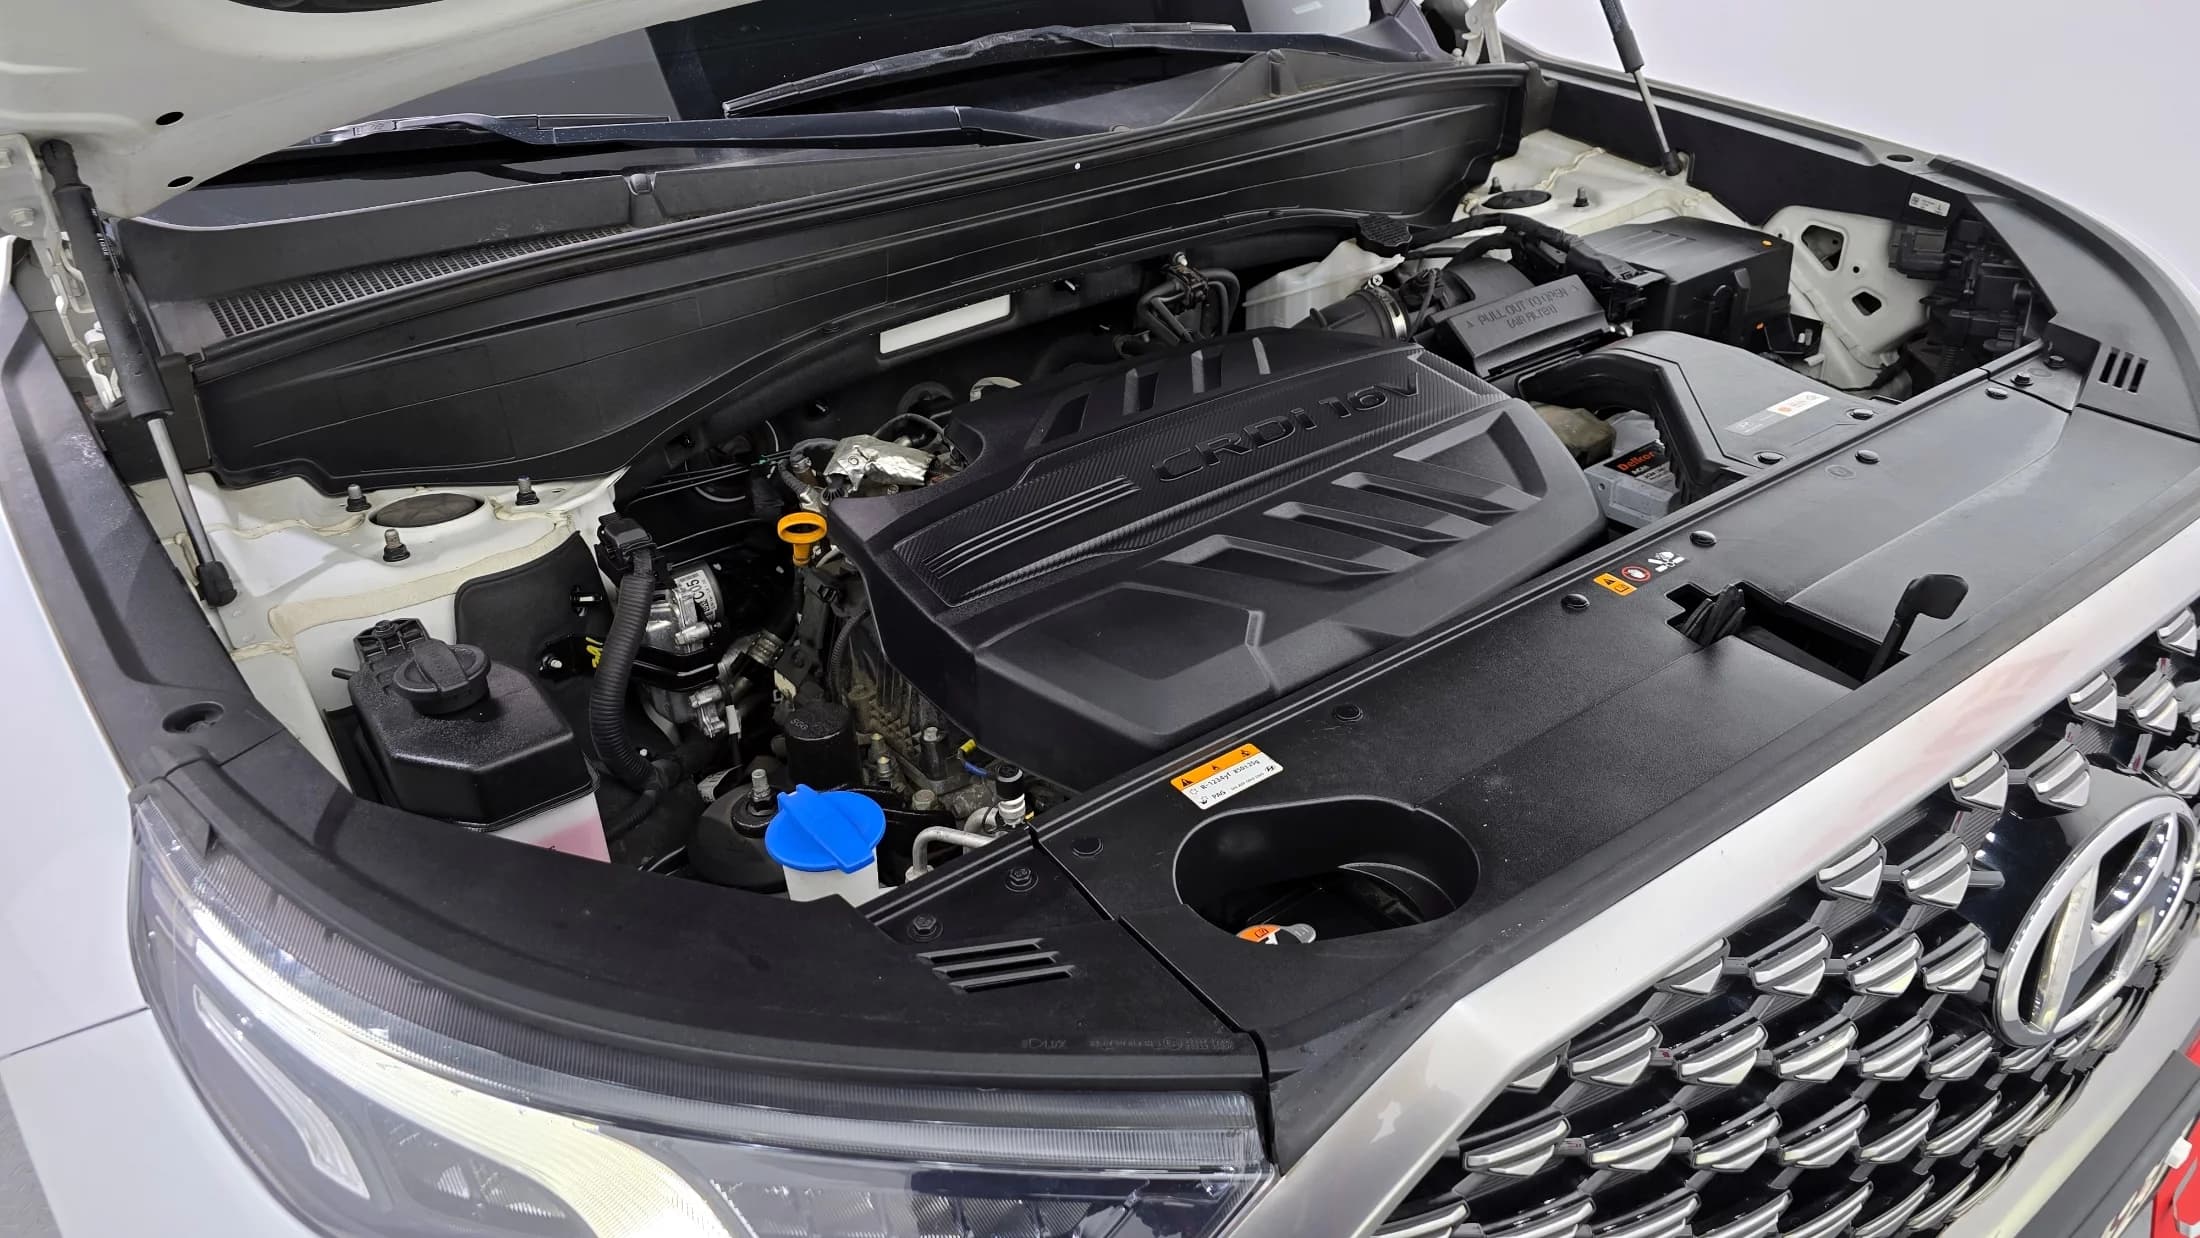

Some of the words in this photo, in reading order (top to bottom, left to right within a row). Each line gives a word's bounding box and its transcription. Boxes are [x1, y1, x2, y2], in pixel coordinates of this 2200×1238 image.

[1478, 308, 1507, 325] PULL
[1504, 300, 1526, 315] OUT
[1527, 296, 1543, 307] TO
[1317, 371, 1420, 419] 16V
